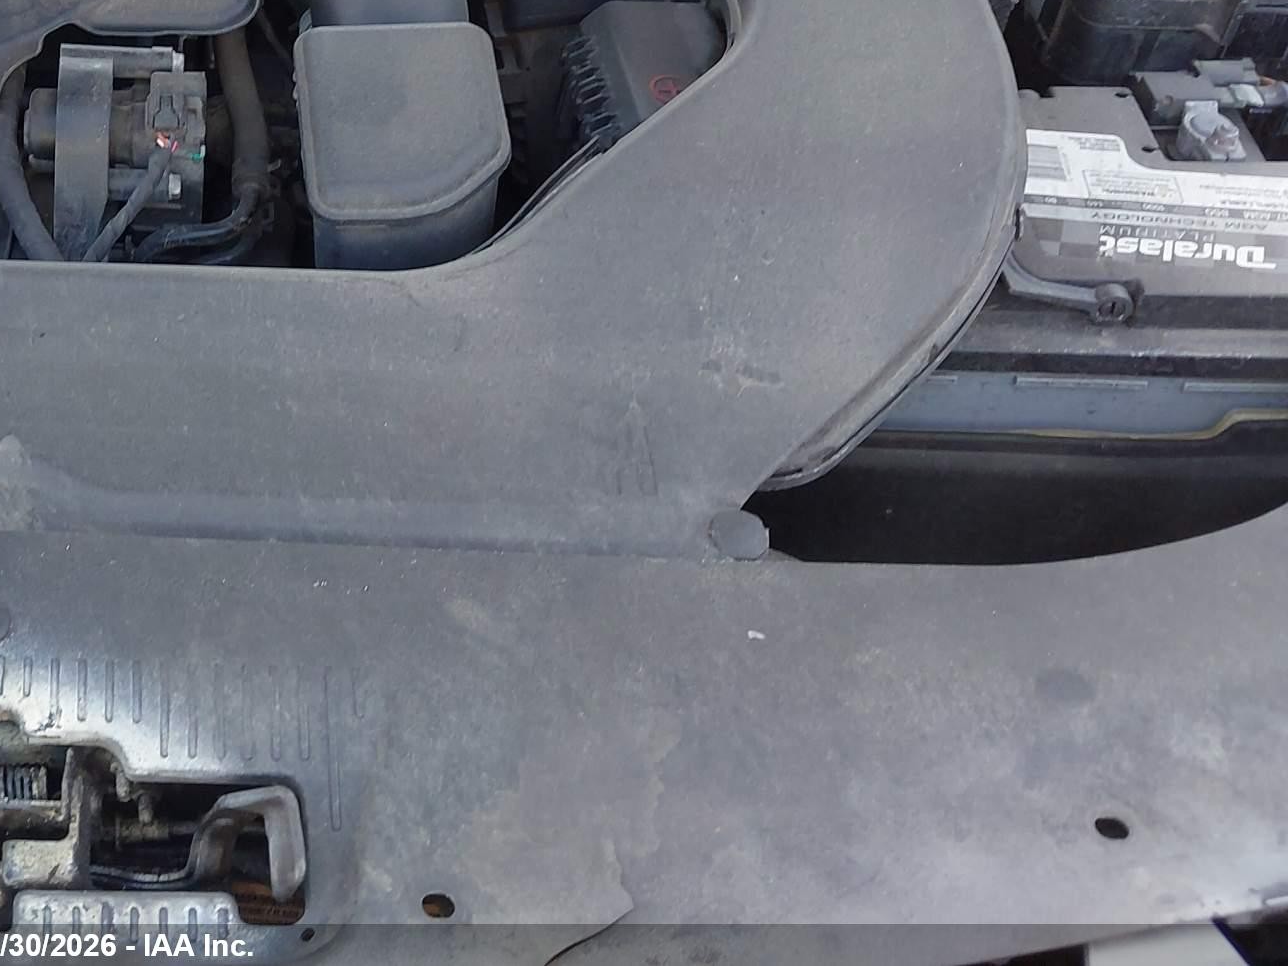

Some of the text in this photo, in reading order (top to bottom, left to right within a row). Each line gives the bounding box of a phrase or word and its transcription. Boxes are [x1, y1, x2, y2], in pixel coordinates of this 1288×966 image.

[1091, 212, 1268, 231] AGM TECHNOLOGY
[1099, 225, 1215, 242] PLATINUM
[1098, 234, 1276, 269] Duralast
